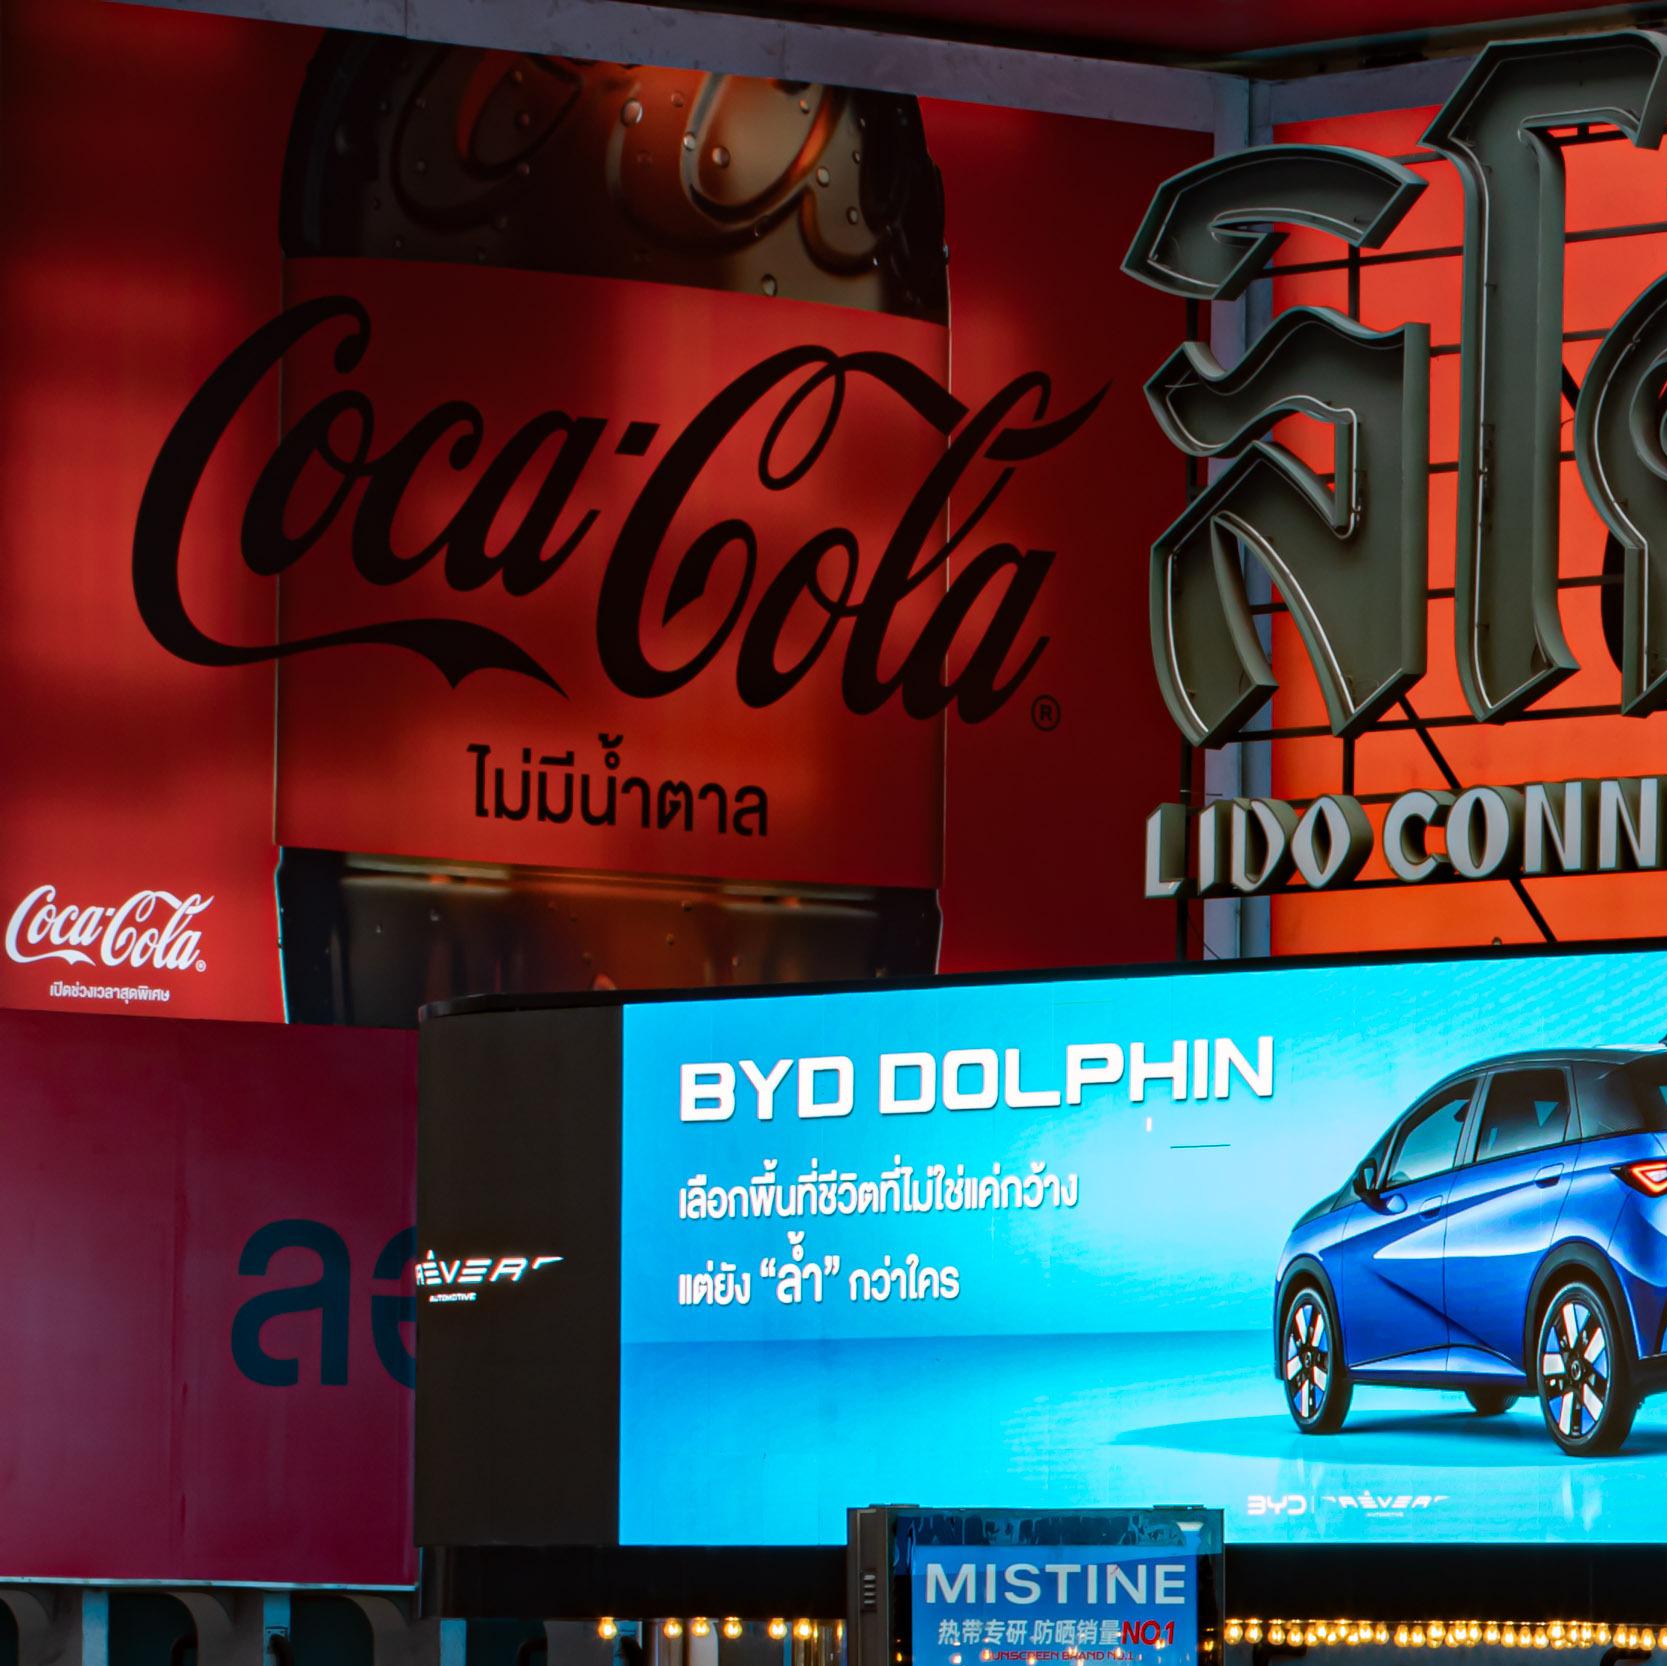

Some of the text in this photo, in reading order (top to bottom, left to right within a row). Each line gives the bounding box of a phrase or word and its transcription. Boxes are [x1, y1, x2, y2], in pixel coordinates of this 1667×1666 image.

[131, 295, 1112, 724] Coca-Cola
[468, 733, 770, 838] ไม่มีน้ำตาล
[1144, 797, 1374, 900] LIDO
[5, 885, 215, 970] Coca-Cola
[679, 1036, 1275, 1122] BYD DOLPHIN
[679, 1153, 1079, 1221] เลือกพื้นที่ชีวิตที่ไม่ใช่แค่กว้าง
[679, 1261, 751, 1306] แต่ยัง
[849, 1256, 961, 1302] กว่าใคร
[1247, 1495, 1307, 1515] BYD
[925, 1563, 1187, 1605] MISTINE
